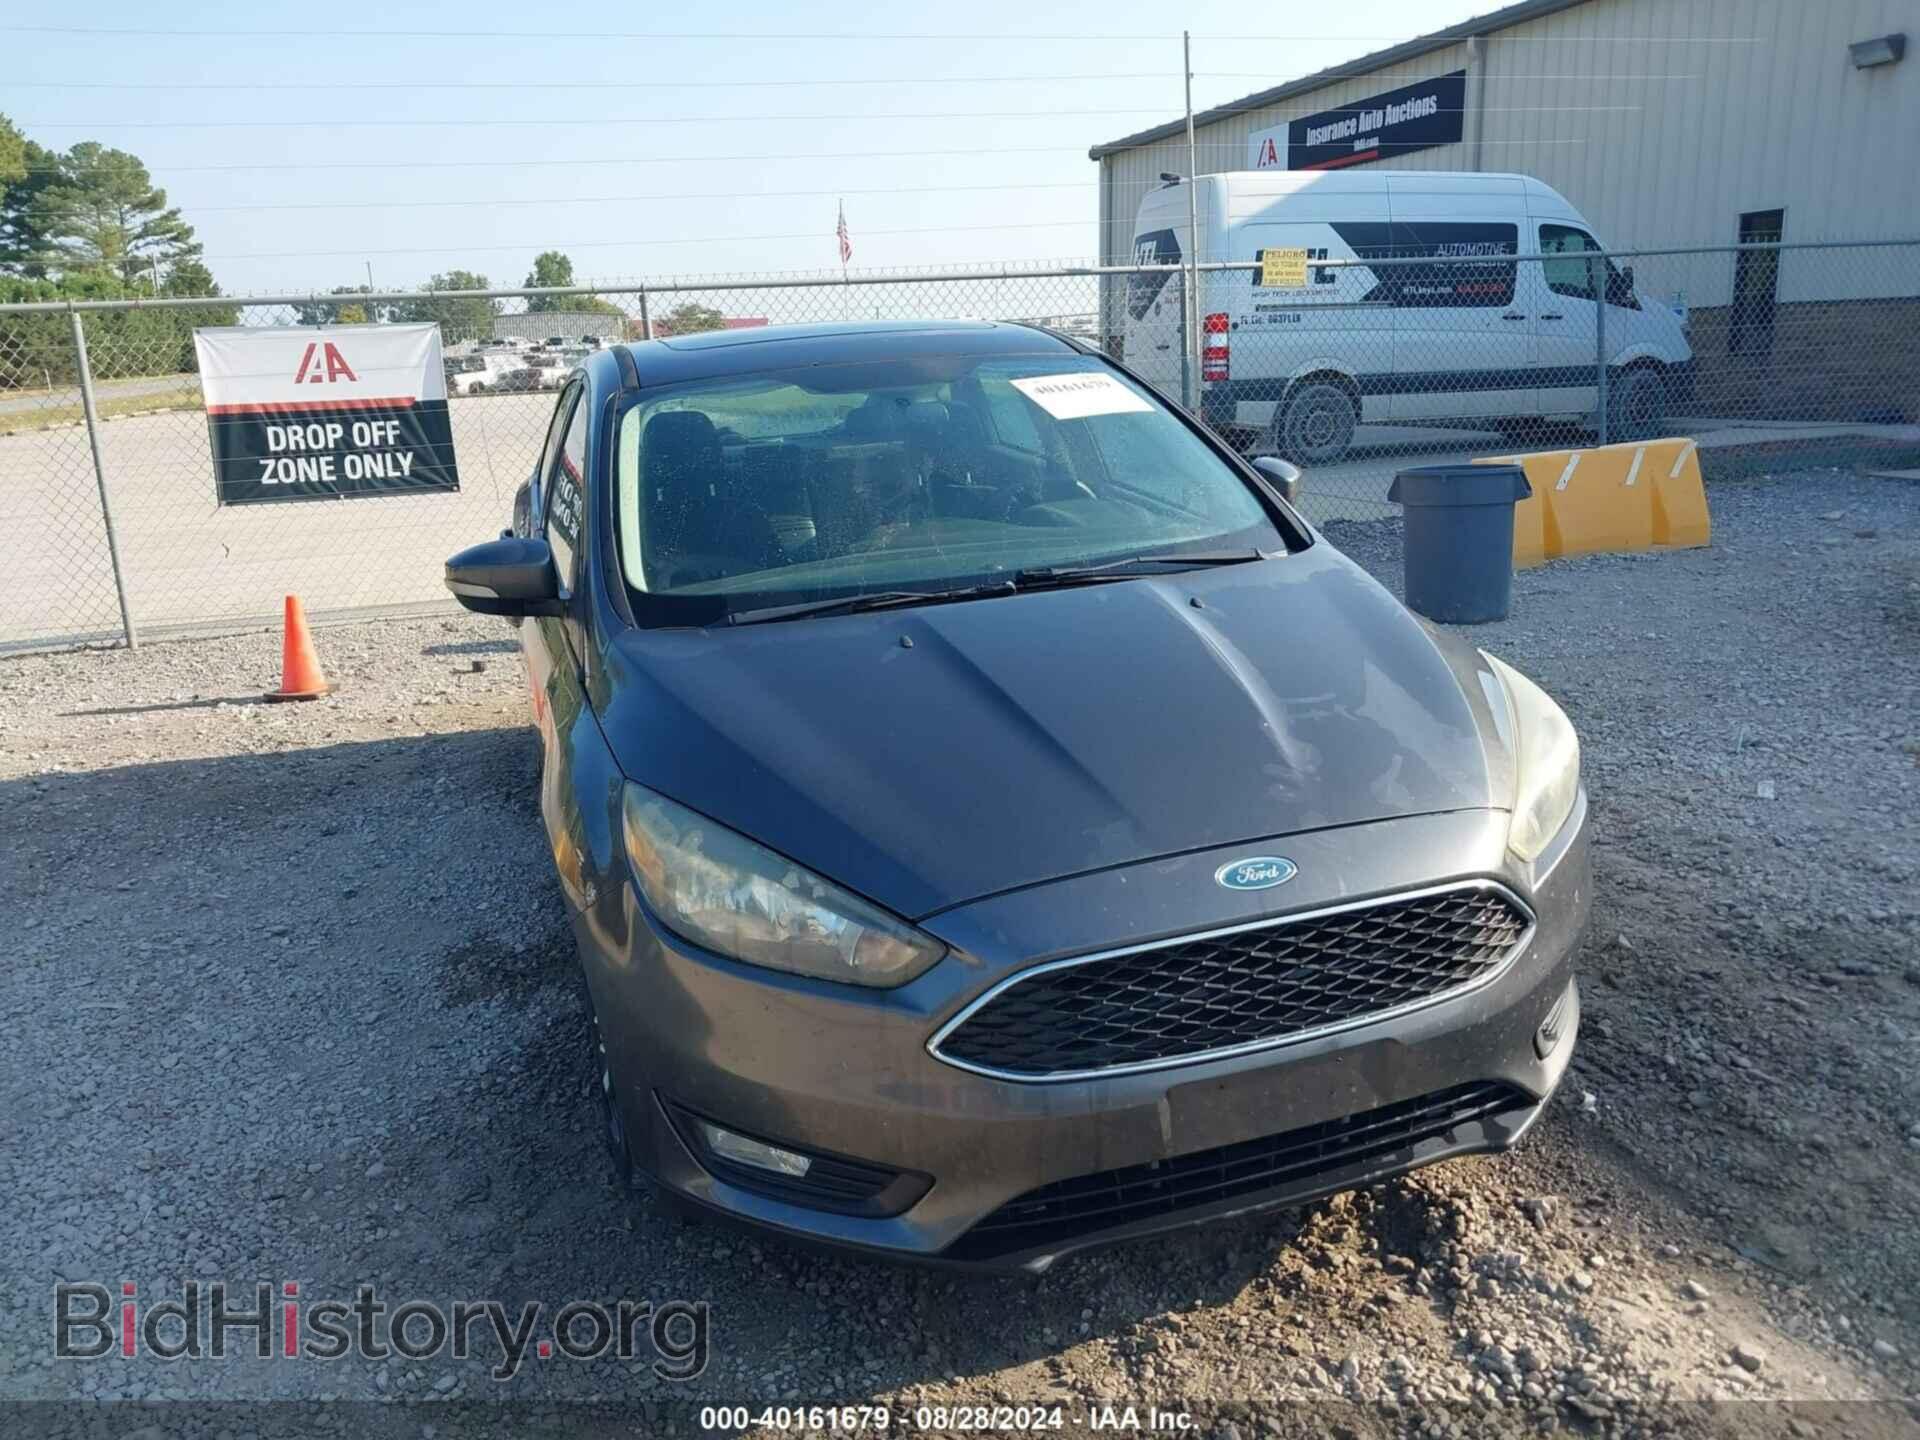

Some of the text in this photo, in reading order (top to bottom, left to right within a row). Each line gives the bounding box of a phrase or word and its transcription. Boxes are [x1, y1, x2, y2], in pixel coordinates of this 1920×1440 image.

[1306, 95, 1437, 147] Insurance Auto Auctions
[1265, 250, 1305, 258] PELIGRO
[1438, 243, 1507, 256] AUTOMOTIVE
[266, 420, 401, 452] DROP OFF
[259, 451, 414, 485] ZONE ONLY
[1236, 863, 1280, 884] Ford
